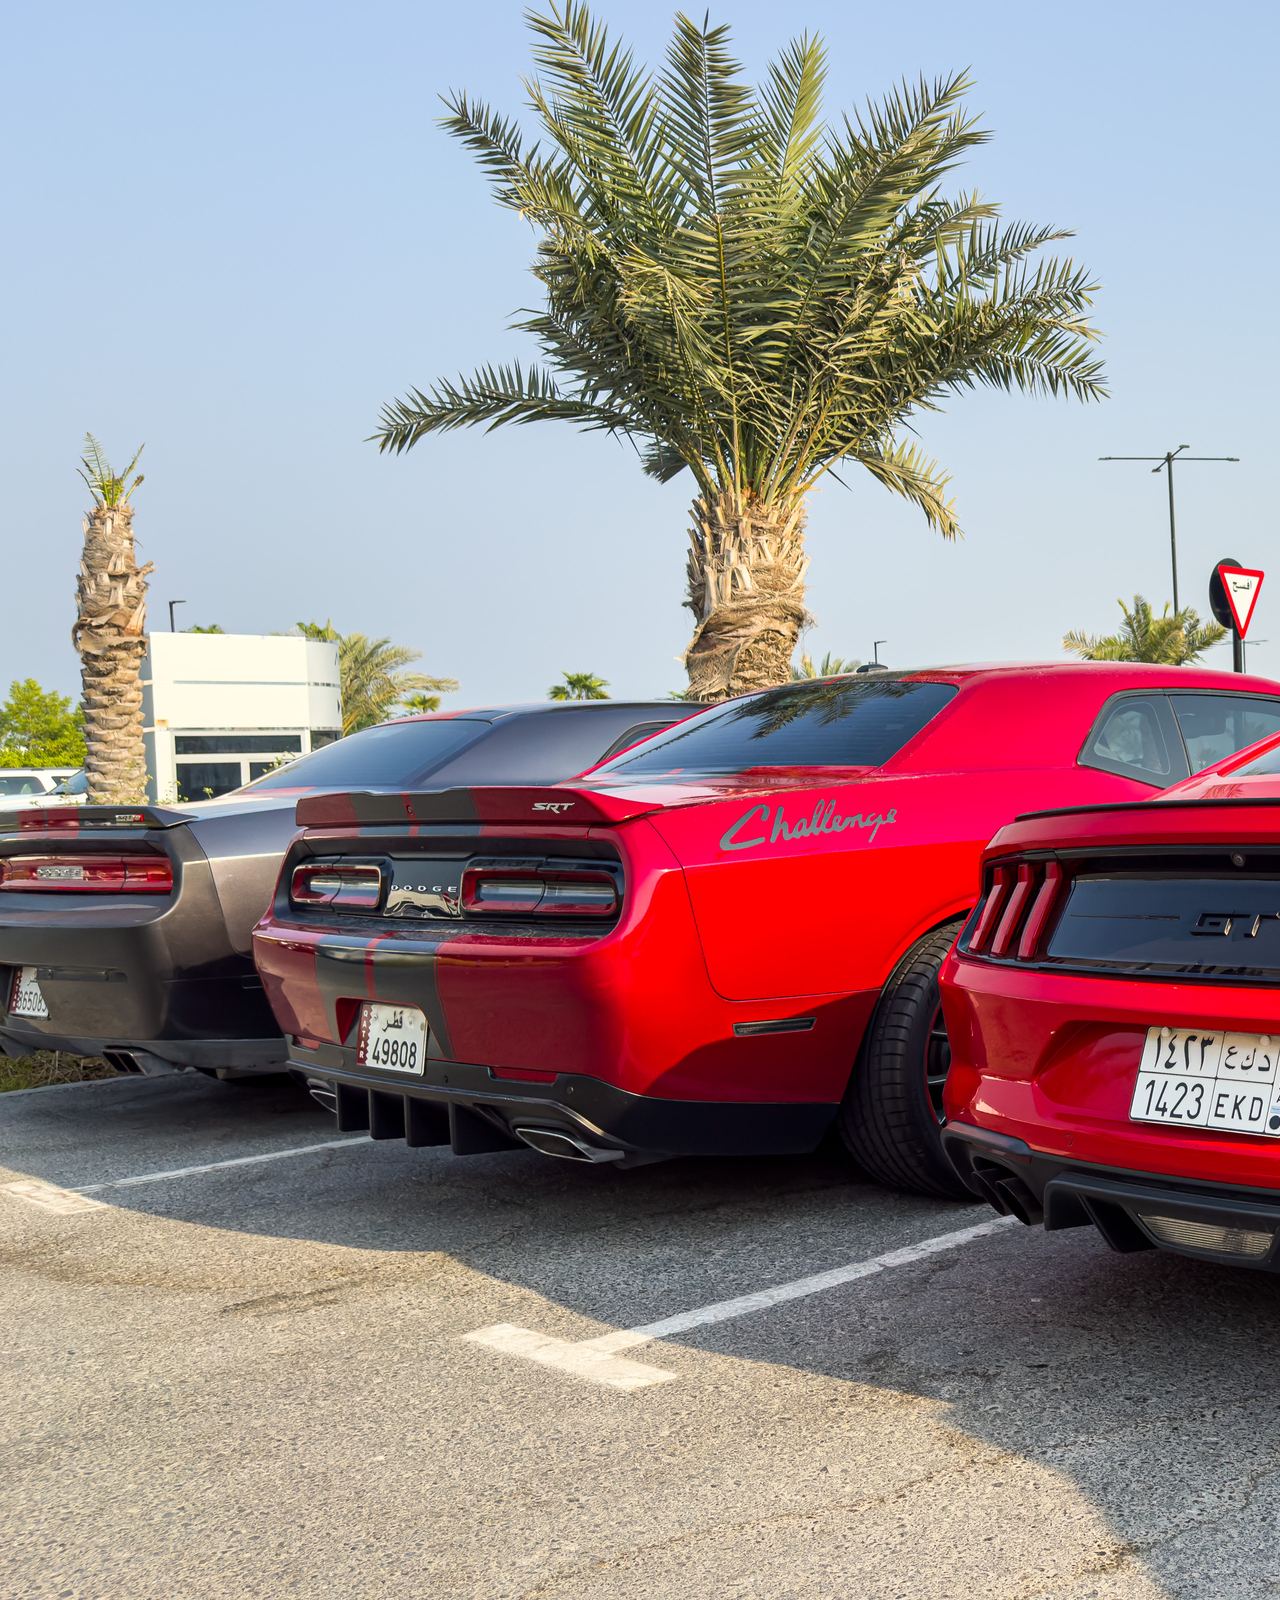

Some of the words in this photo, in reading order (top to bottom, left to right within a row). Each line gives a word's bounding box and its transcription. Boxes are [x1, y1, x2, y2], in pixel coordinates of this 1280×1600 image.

[531, 802, 575, 814] SRT
[391, 884, 458, 893] DODGE
[359, 1009, 369, 1058] QATAR
[382, 1009, 404, 1032] قطر
[372, 1037, 417, 1069] 49808
[1154, 1033, 1215, 1071] ١٤٢٣
[1145, 1079, 1205, 1120] 1423
[1214, 1093, 1264, 1122] EKD
